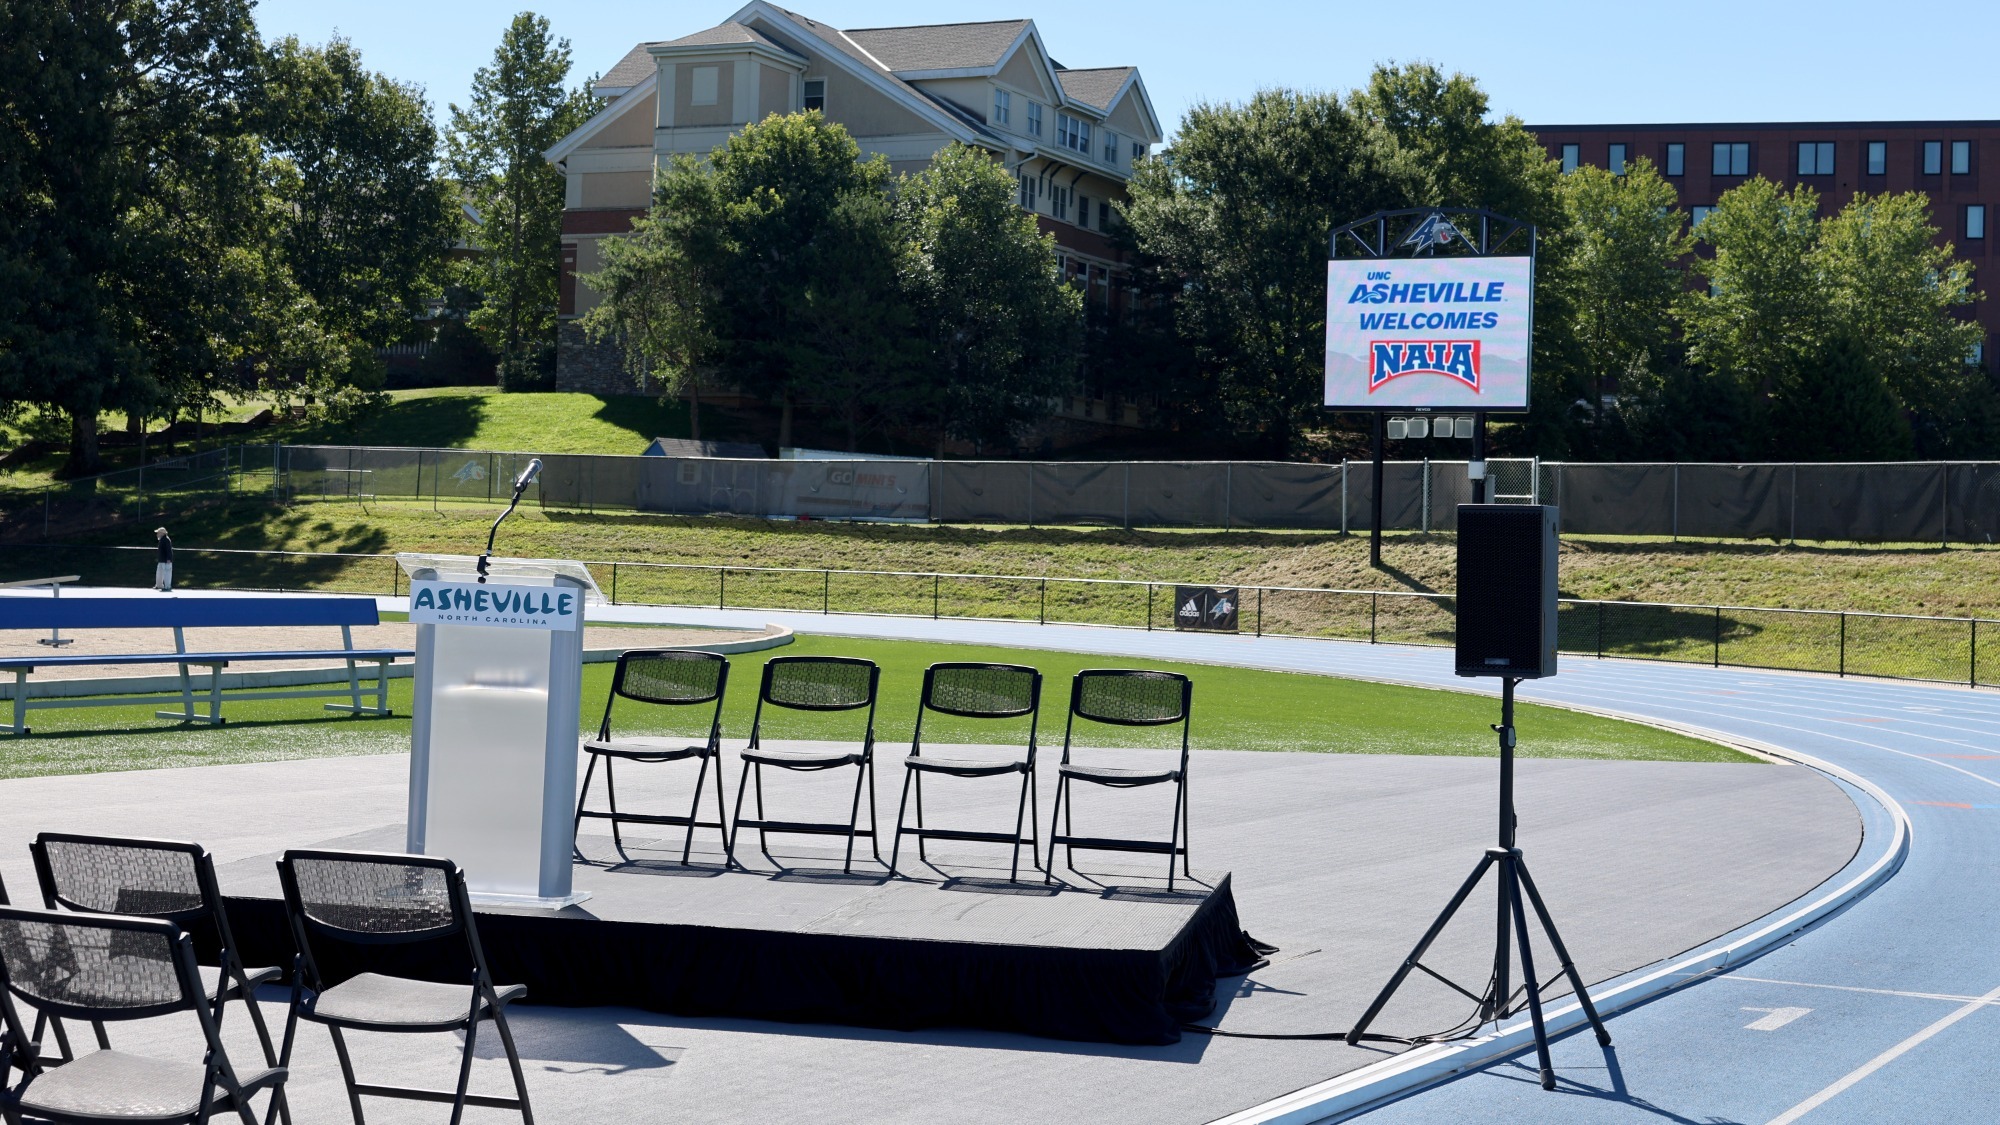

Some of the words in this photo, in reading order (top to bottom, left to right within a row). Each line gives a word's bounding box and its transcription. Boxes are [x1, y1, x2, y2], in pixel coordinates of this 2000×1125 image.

[1367, 271, 1392, 281] UNC
[1348, 282, 1505, 304] ASHEVILLE
[1359, 311, 1499, 330] WELCOMES
[1372, 342, 1477, 386] NAIA
[414, 587, 574, 616] ASHEVILLE
[438, 614, 478, 622] NORTH
[485, 616, 548, 625] CAROLINA
